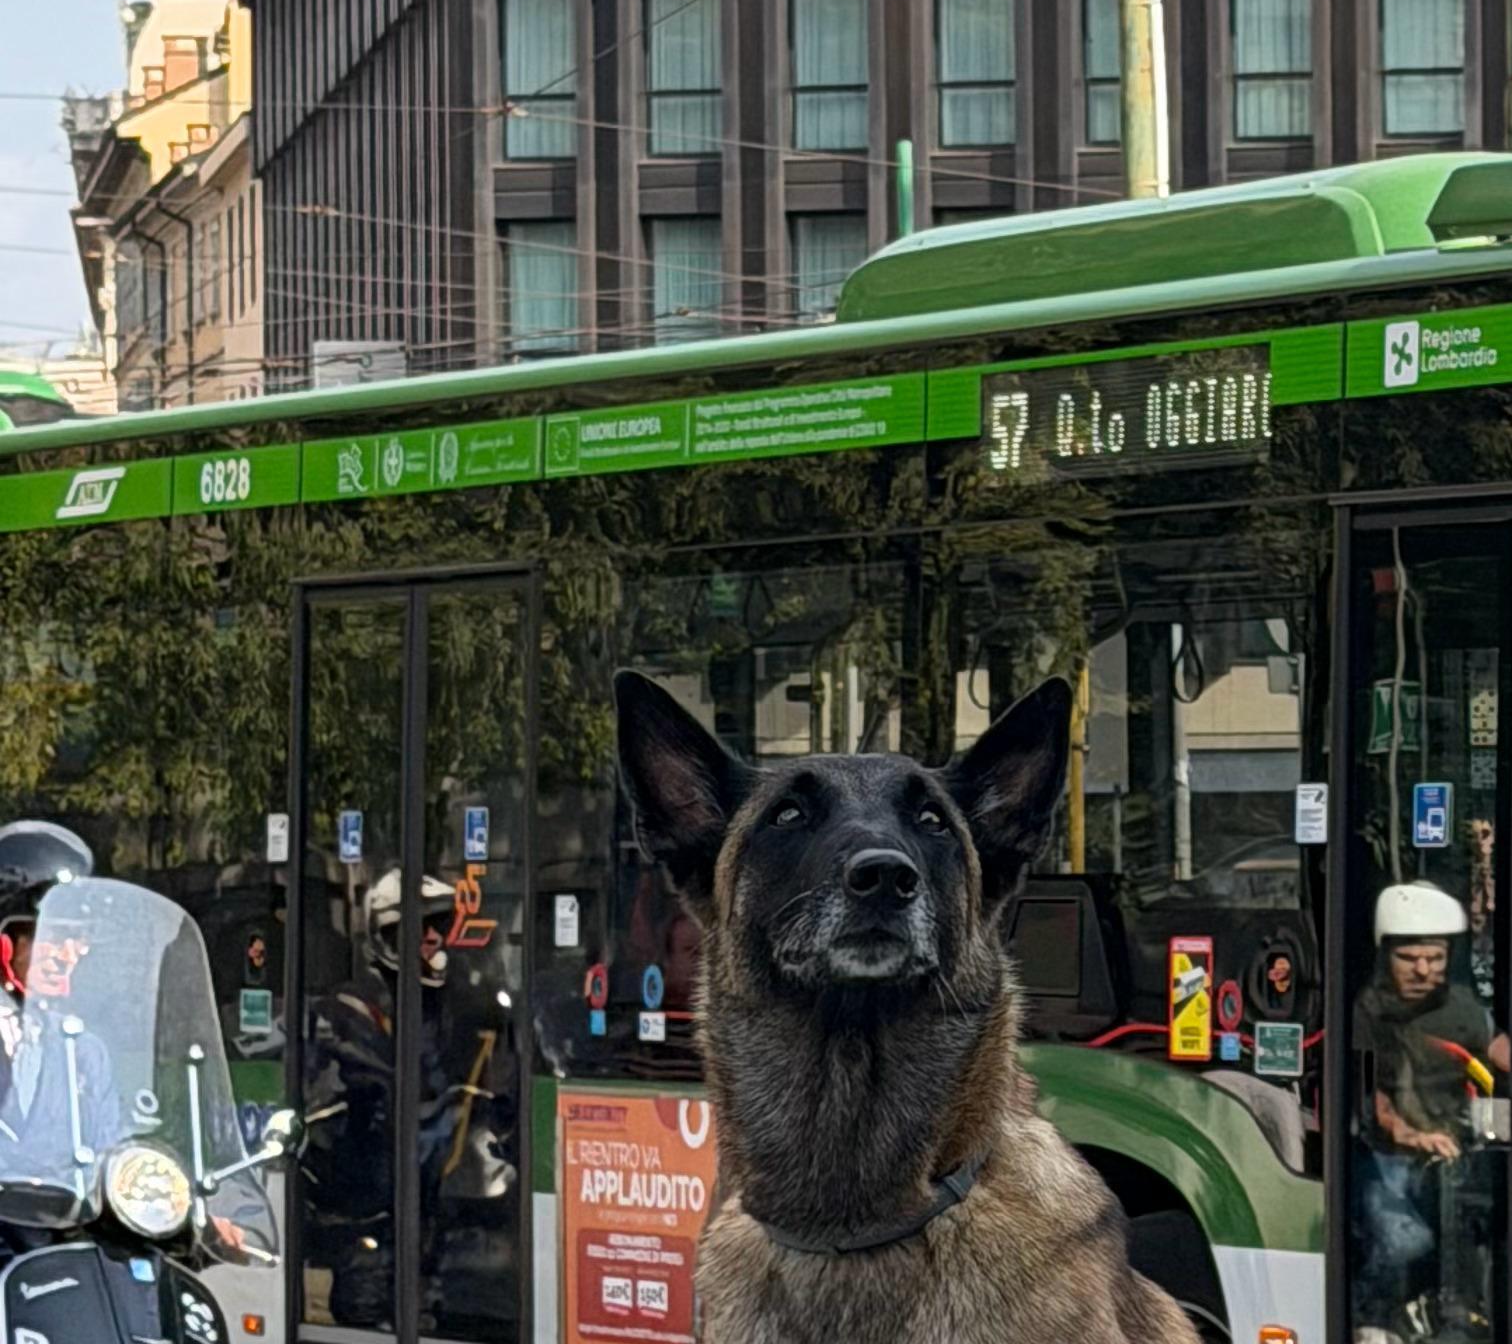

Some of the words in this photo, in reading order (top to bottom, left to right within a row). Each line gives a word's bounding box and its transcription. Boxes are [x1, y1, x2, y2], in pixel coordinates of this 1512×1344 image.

[1421, 325, 1481, 349] Regione
[1421, 344, 1498, 373] Lombardia
[990, 392, 1029, 469] 57
[200, 457, 251, 505] 6828
[641, 1144, 662, 1169] VA
[581, 1167, 706, 1212] APPLAUDITO
